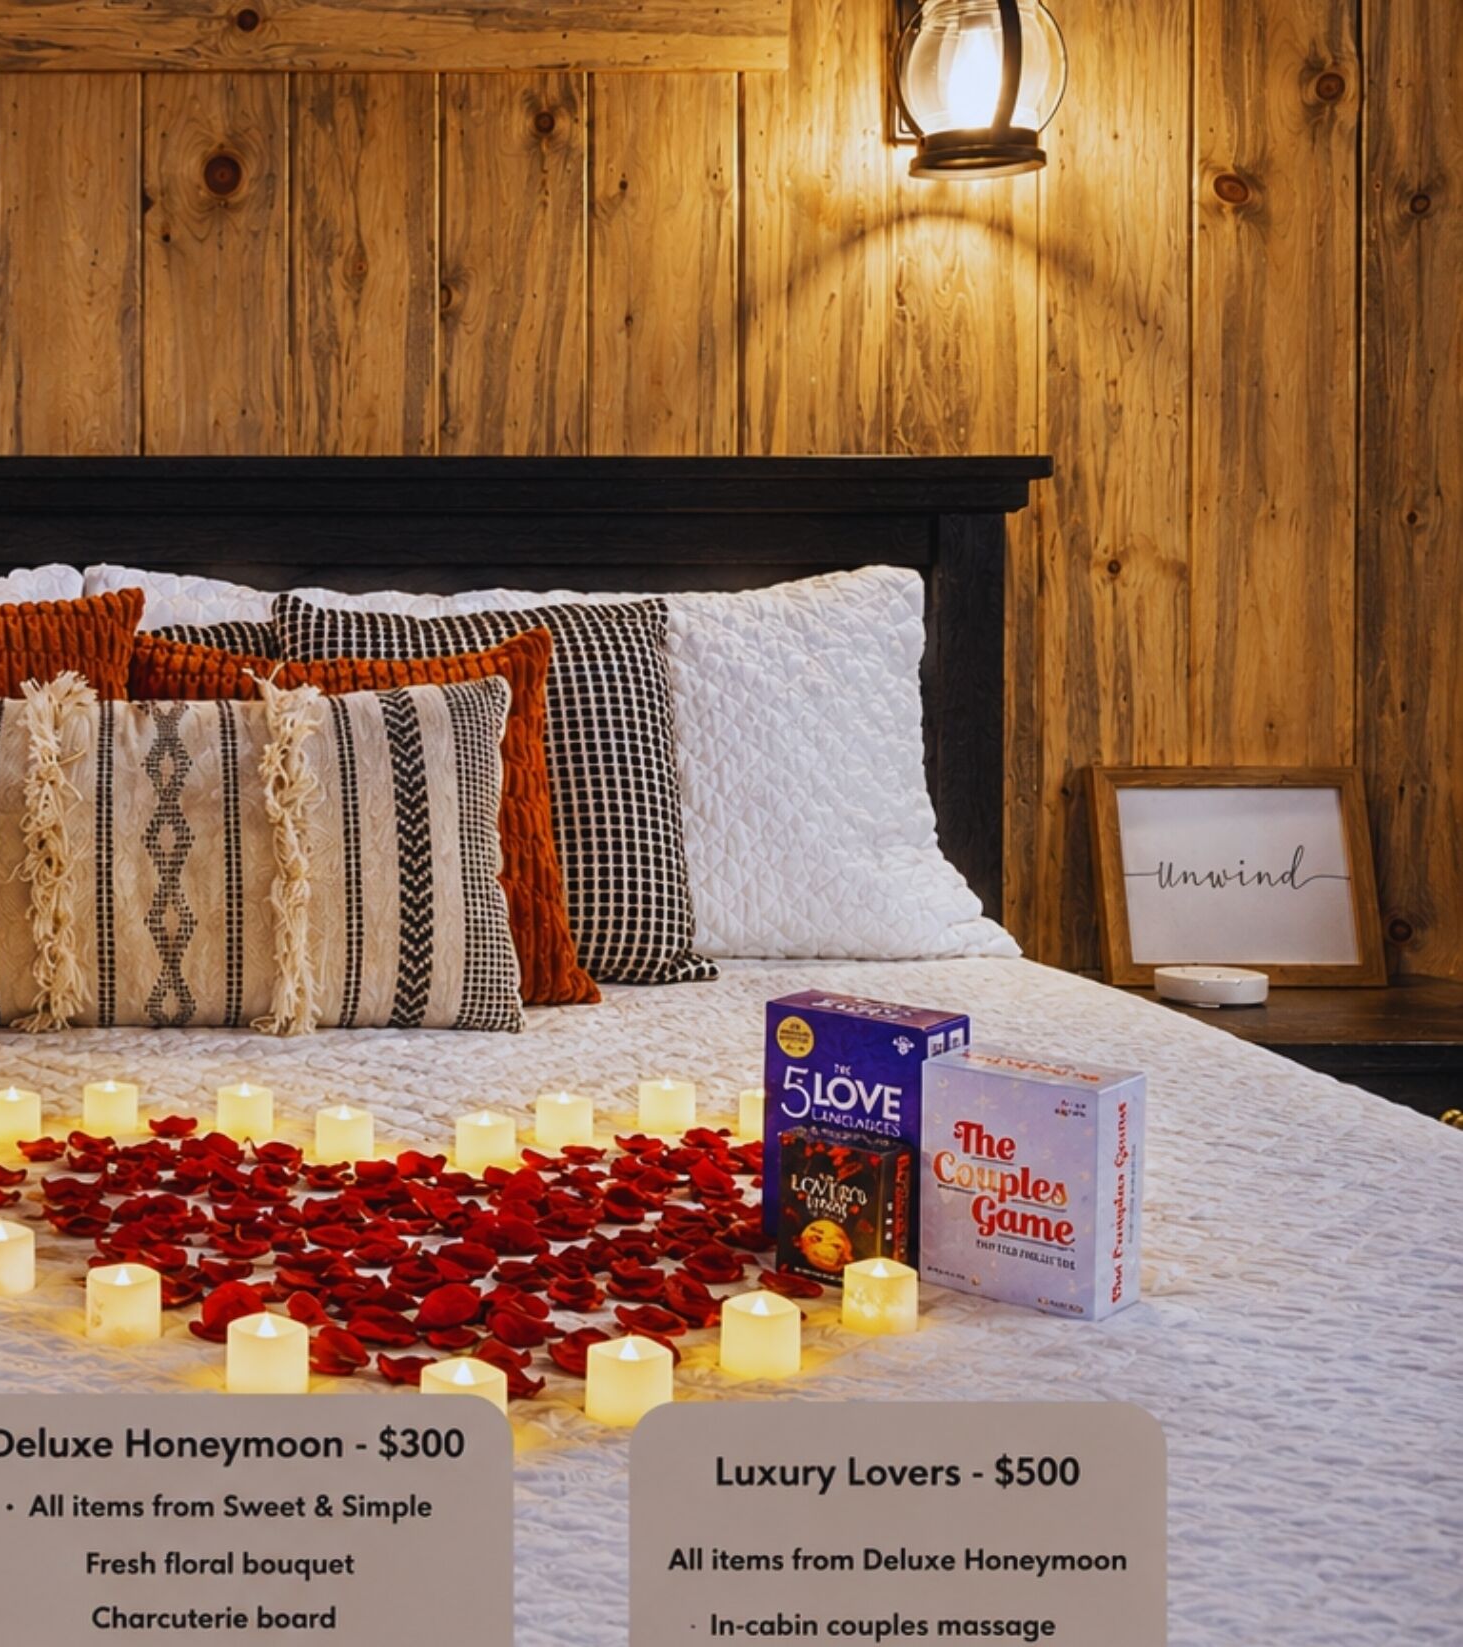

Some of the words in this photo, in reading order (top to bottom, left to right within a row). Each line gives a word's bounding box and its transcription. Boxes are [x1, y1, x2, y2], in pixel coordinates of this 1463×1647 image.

[780, 1065, 811, 1119] 5
[813, 1071, 903, 1122] LOVE
[953, 1120, 1016, 1161] The
[933, 1150, 1068, 1206] Couples
[971, 1194, 1076, 1246] Game
